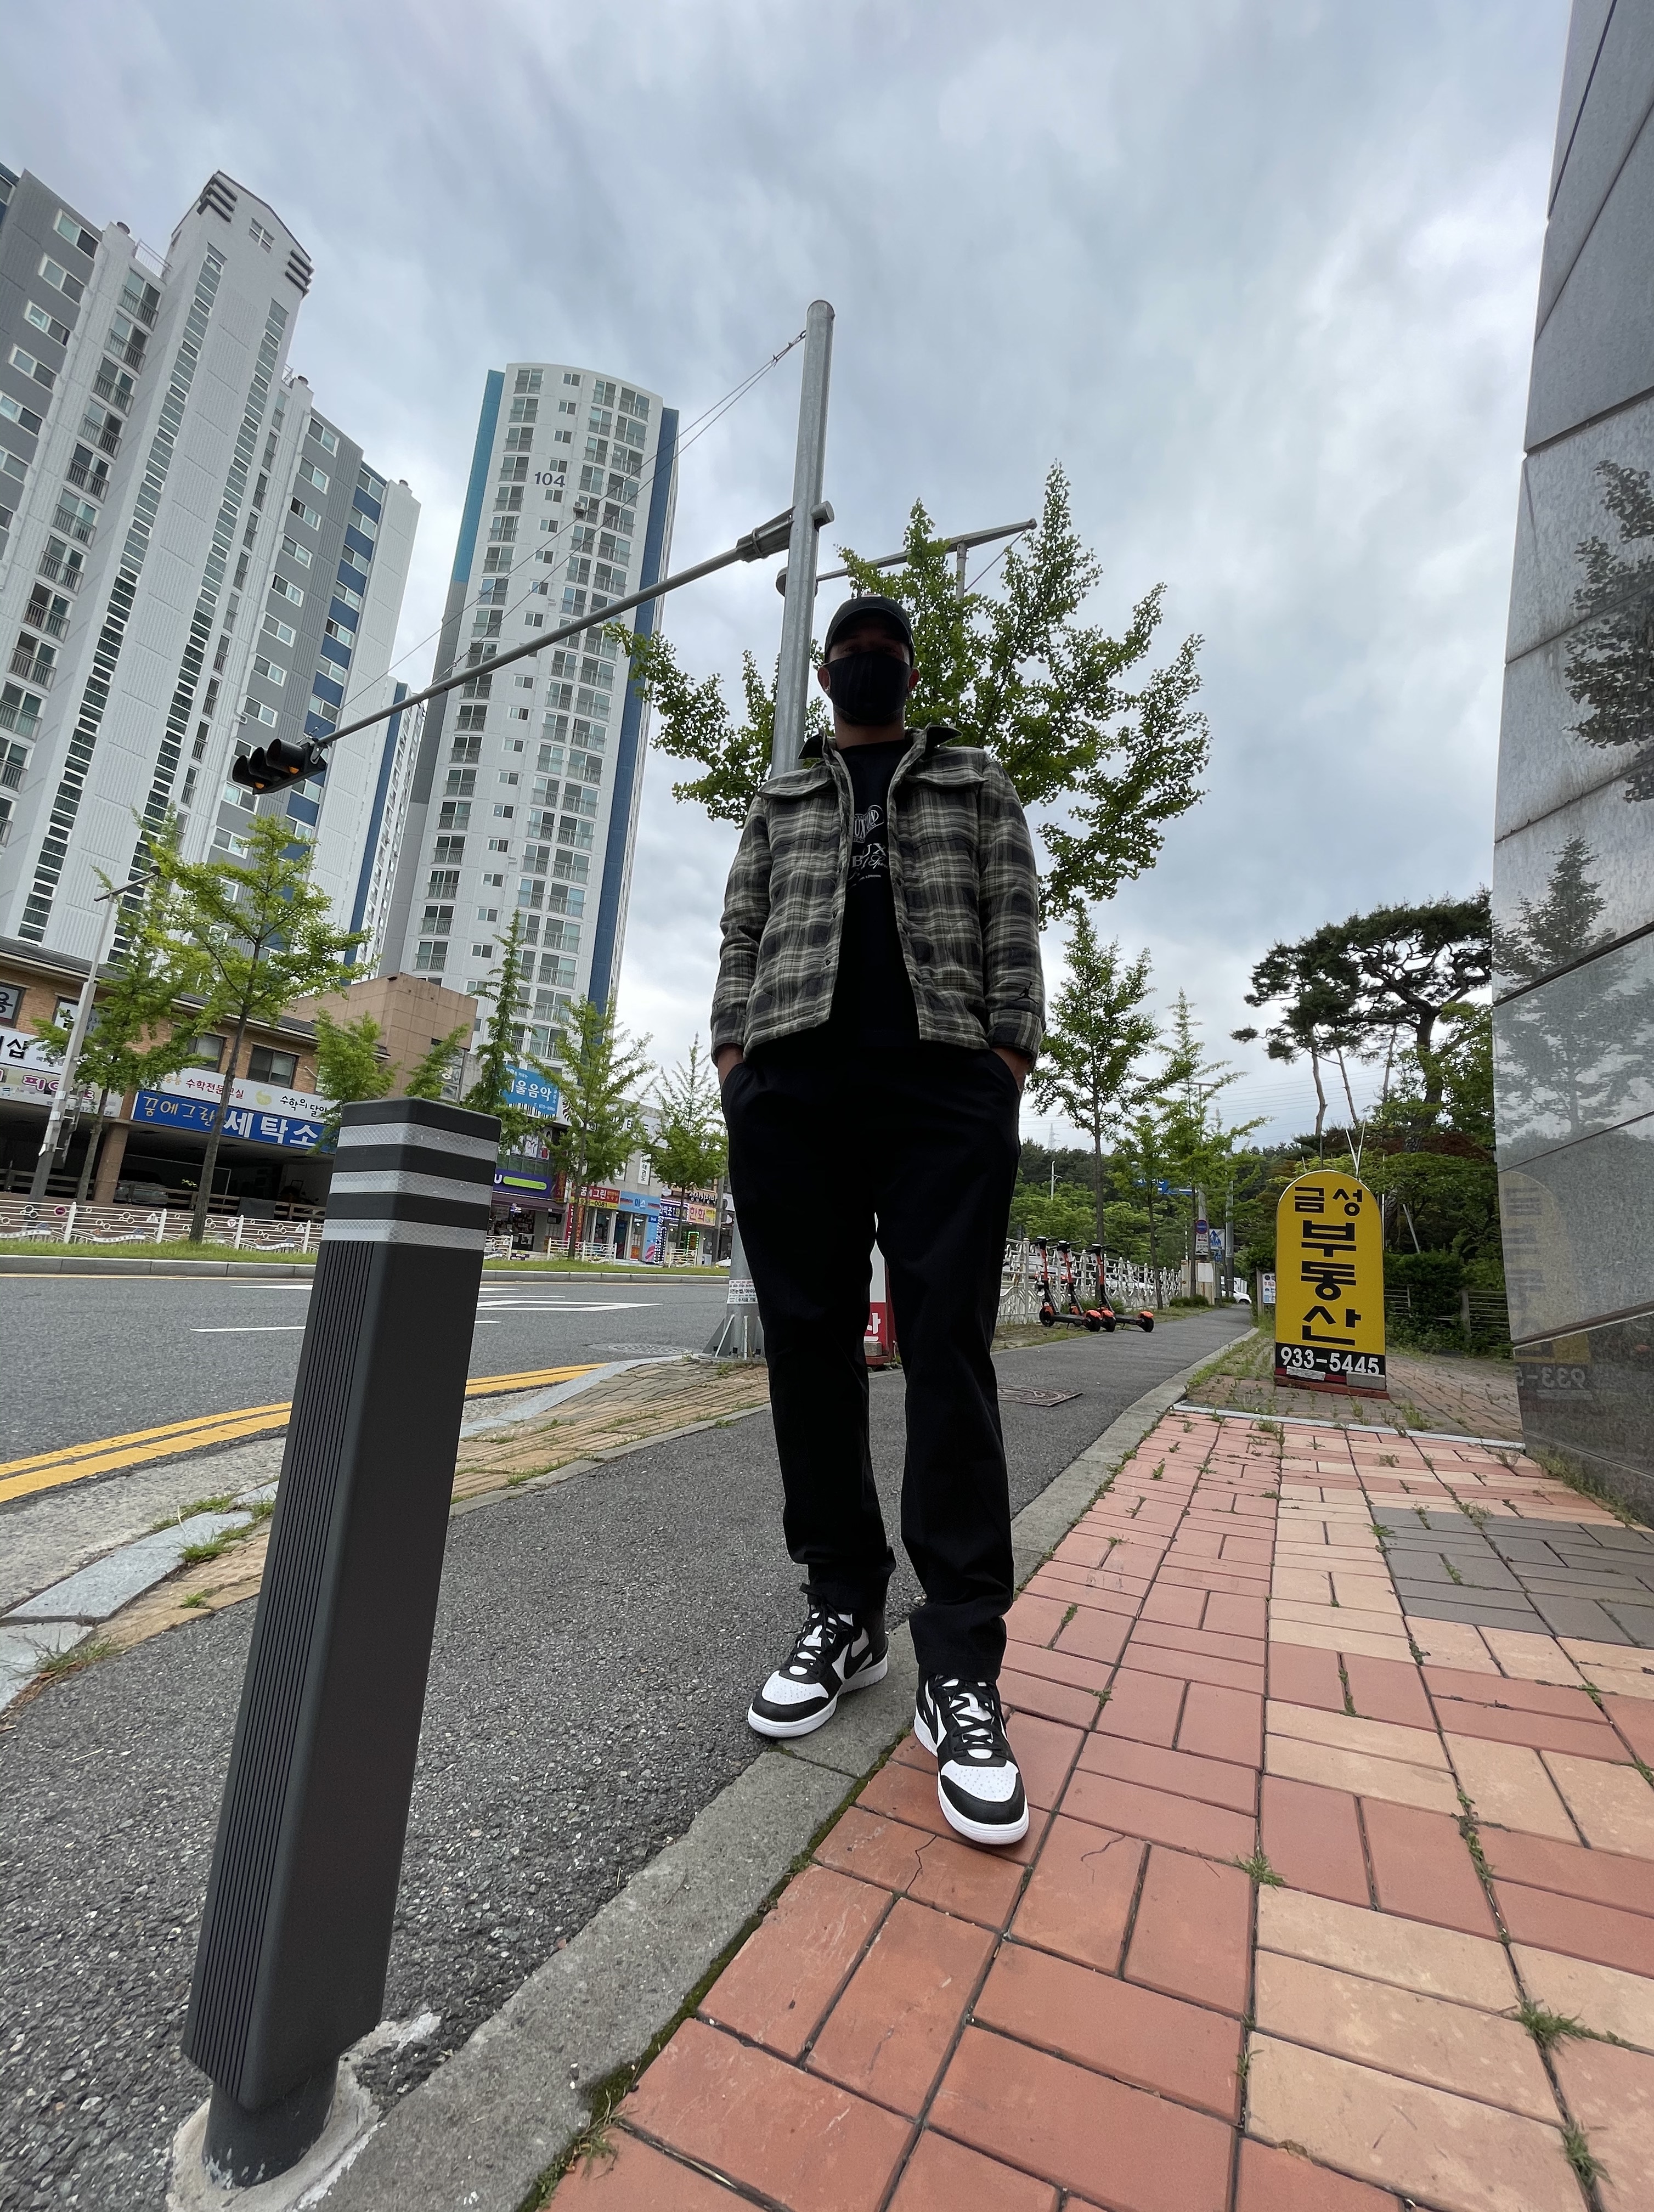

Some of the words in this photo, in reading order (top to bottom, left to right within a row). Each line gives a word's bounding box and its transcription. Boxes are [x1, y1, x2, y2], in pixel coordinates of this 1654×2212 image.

[535, 472, 565, 488] 104
[511, 1080, 552, 1102] 울음악
[280, 1095, 307, 1111] 수학의
[223, 1110, 319, 1147] 세탁소
[494, 1173, 503, 1184] U
[1294, 1186, 1363, 1216] 금성
[690, 1207, 705, 1221] 한화
[1301, 1220, 1362, 1346] 부동산
[1280, 1347, 1380, 1375] 933-5445
